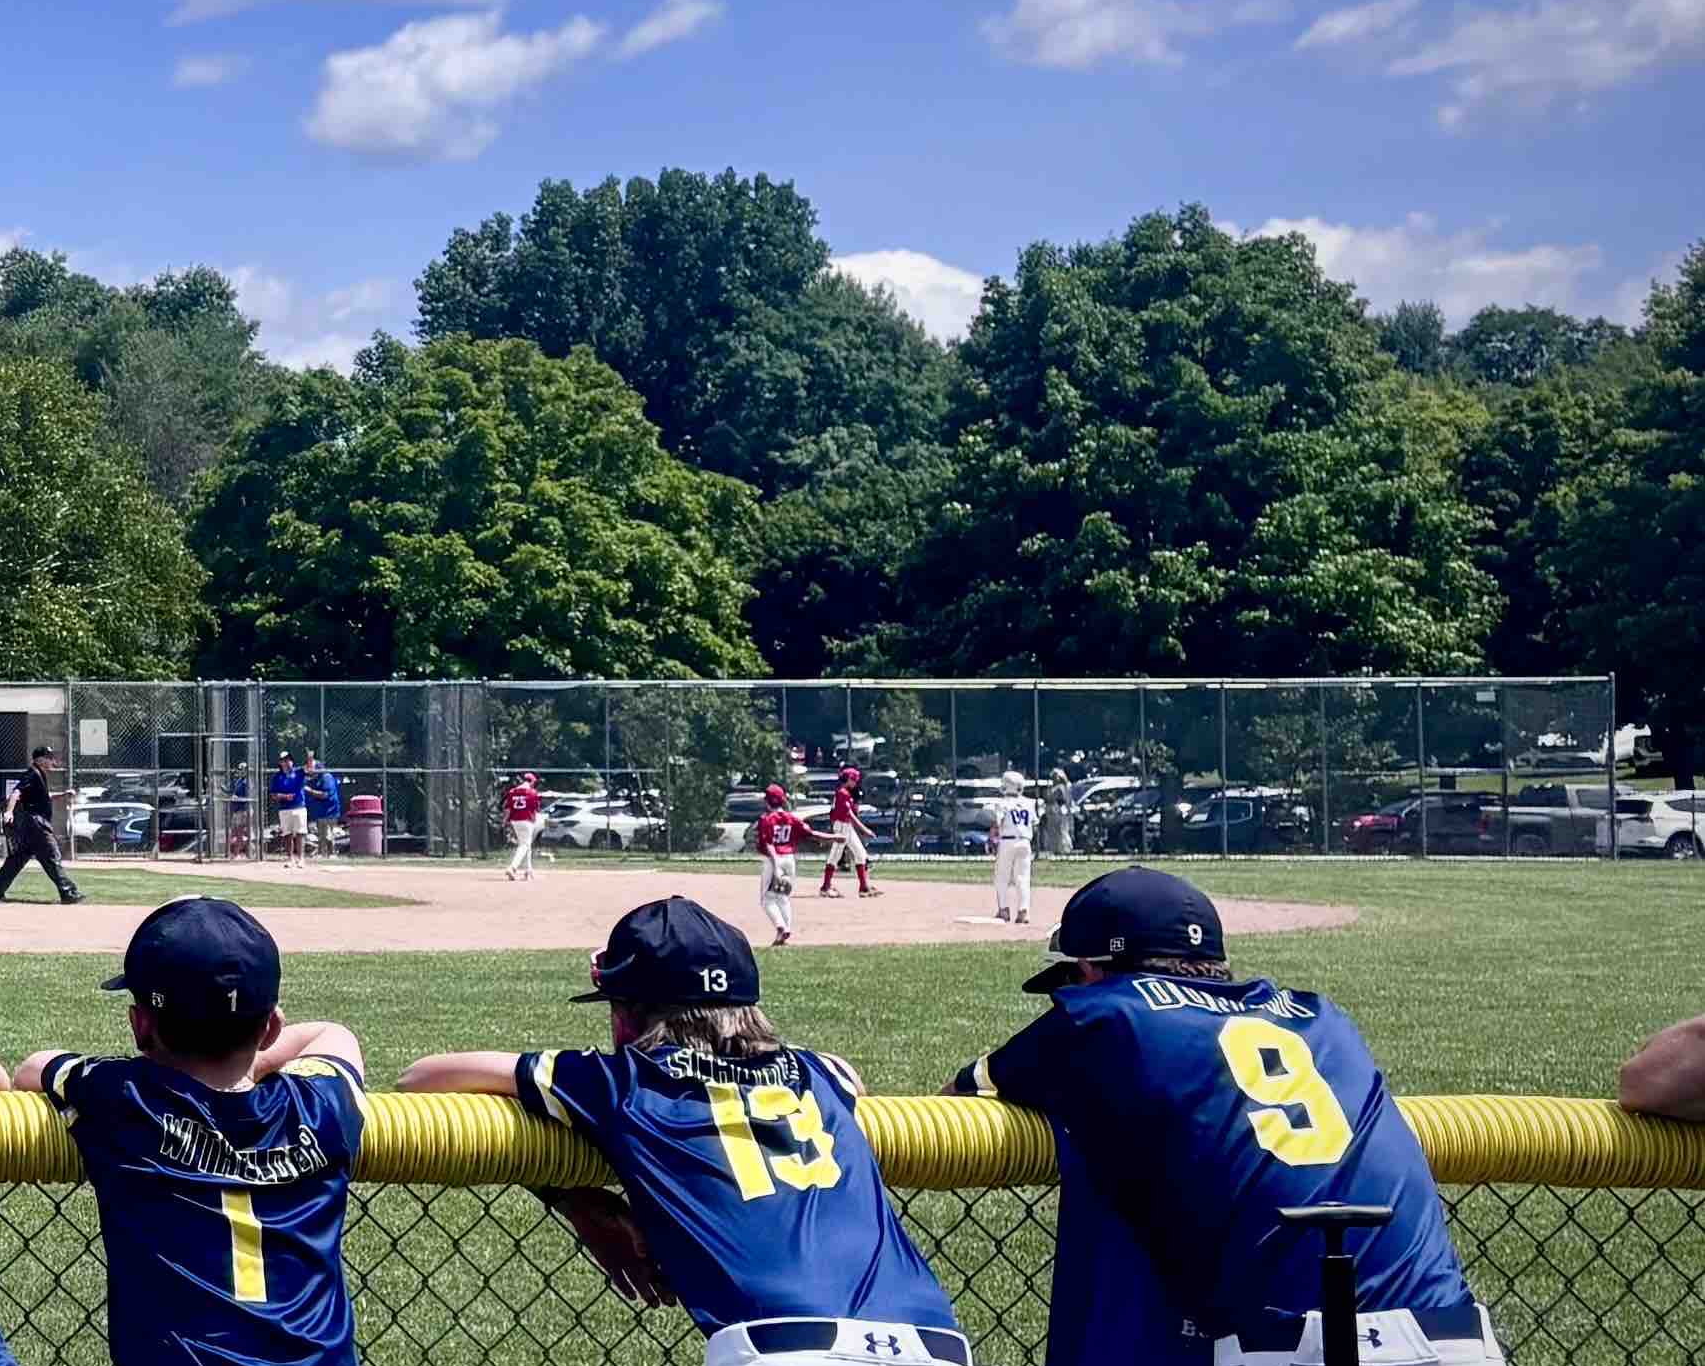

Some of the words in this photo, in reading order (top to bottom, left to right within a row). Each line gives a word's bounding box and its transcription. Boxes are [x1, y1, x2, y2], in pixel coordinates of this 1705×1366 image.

[1188, 923, 1203, 946] 9
[226, 989, 237, 1013] 1
[700, 968, 728, 993] 13
[1217, 1016, 1354, 1167] 9
[706, 1082, 843, 1202] 13
[221, 1189, 268, 1303] 1
